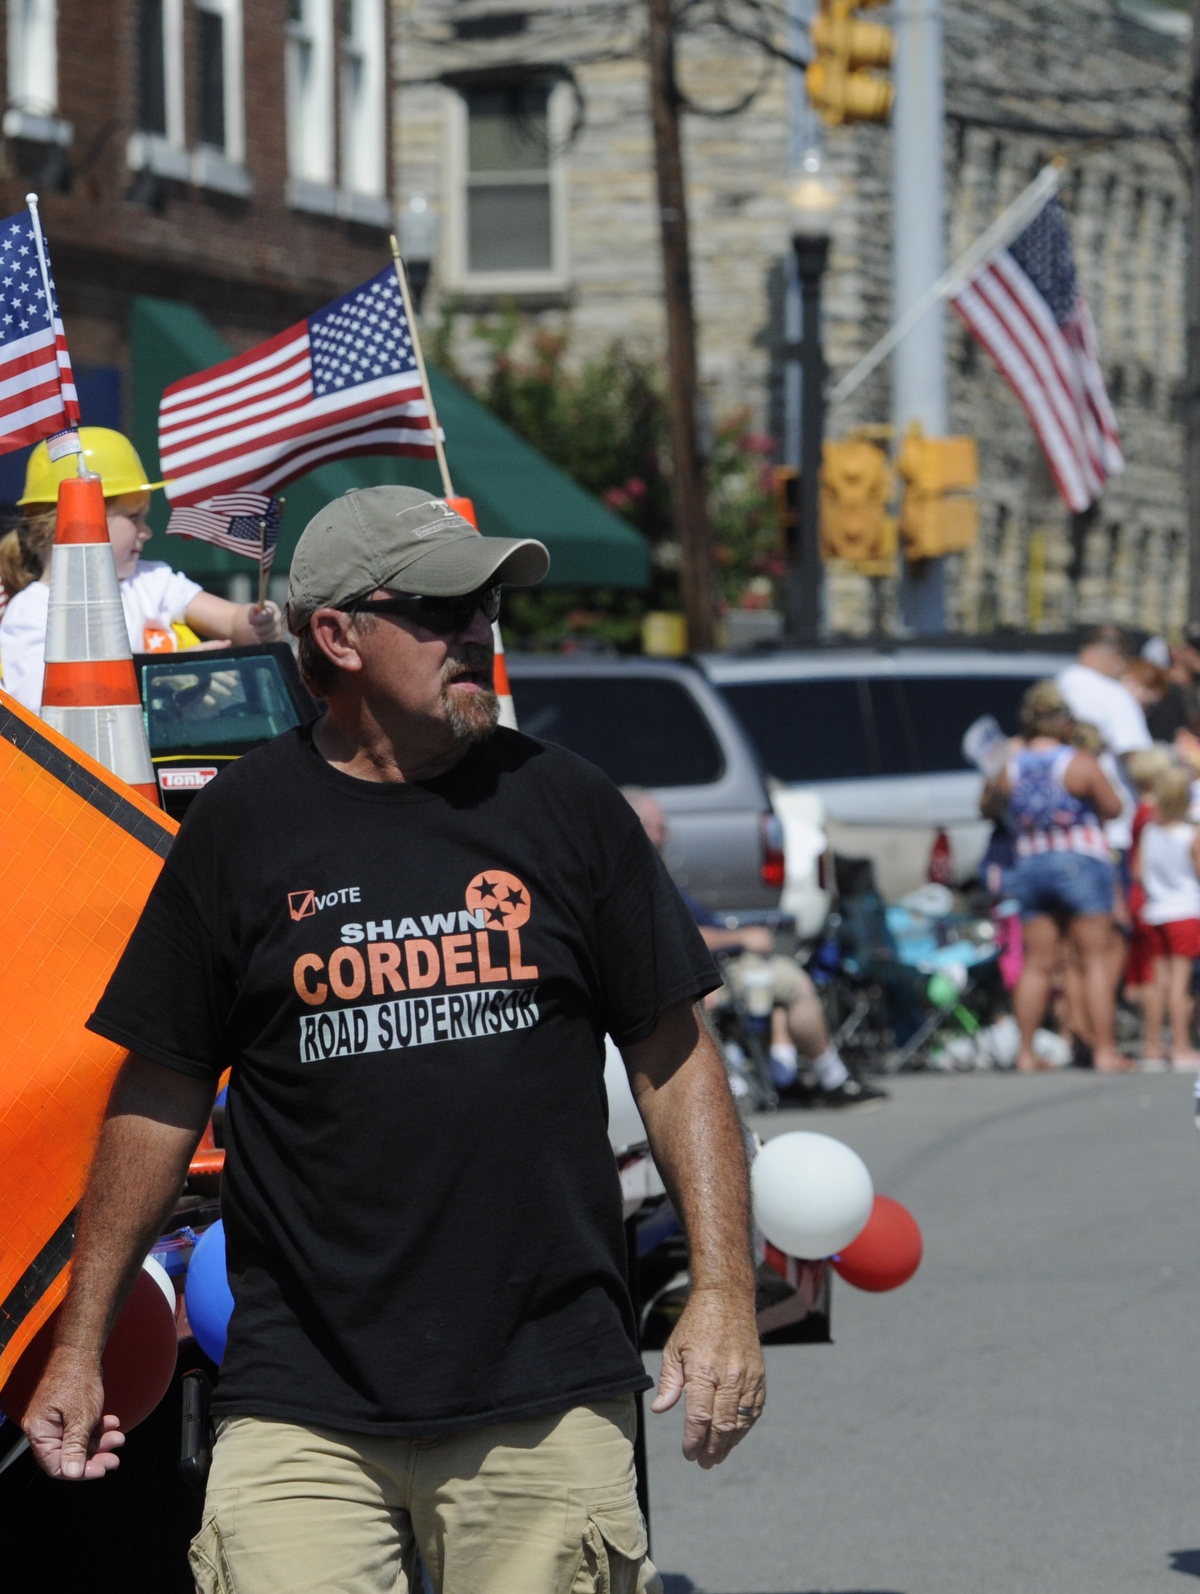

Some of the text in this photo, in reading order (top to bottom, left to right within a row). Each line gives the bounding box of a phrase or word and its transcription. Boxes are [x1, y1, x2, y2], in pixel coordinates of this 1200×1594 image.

[314, 887, 362, 911] VOTE
[340, 908, 486, 944] SHAWN
[293, 928, 539, 1006] CORDELL
[304, 989, 538, 1062] ROAD SUPERVISOR
